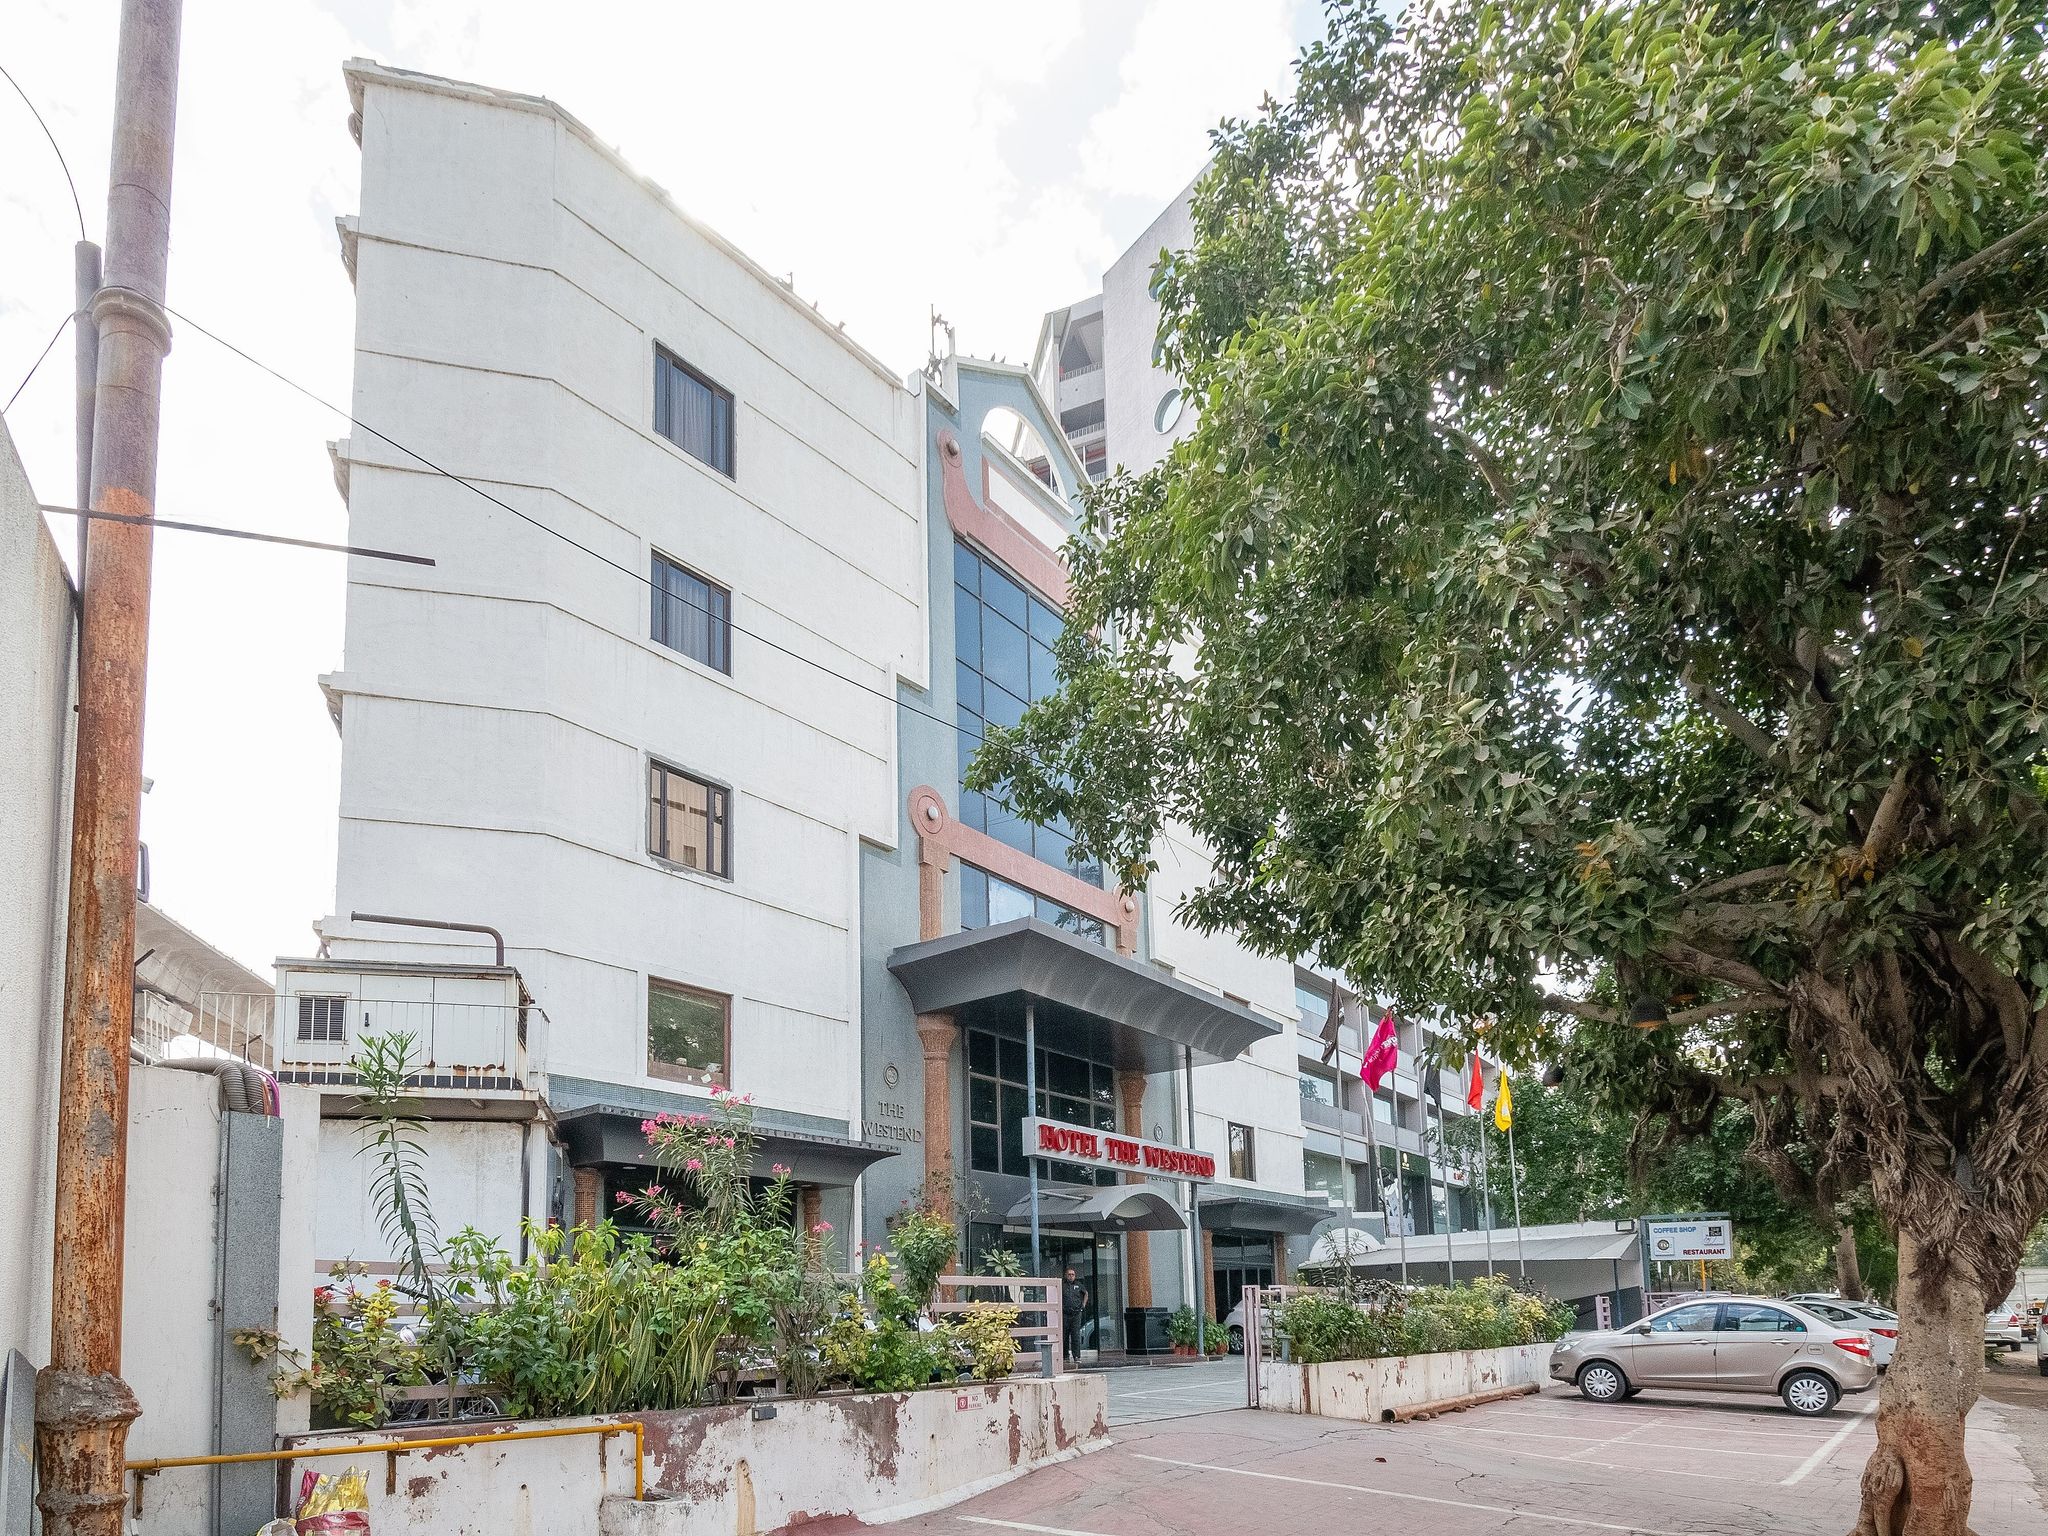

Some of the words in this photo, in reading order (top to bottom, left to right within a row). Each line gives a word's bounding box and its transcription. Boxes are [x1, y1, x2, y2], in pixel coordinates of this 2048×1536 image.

[878, 1101, 904, 1119] THE
[861, 1119, 922, 1143] WESTEND
[1038, 1125, 1102, 1159] HOTEL
[1105, 1137, 1140, 1165] THE
[1142, 1145, 1216, 1178] WESTEND
